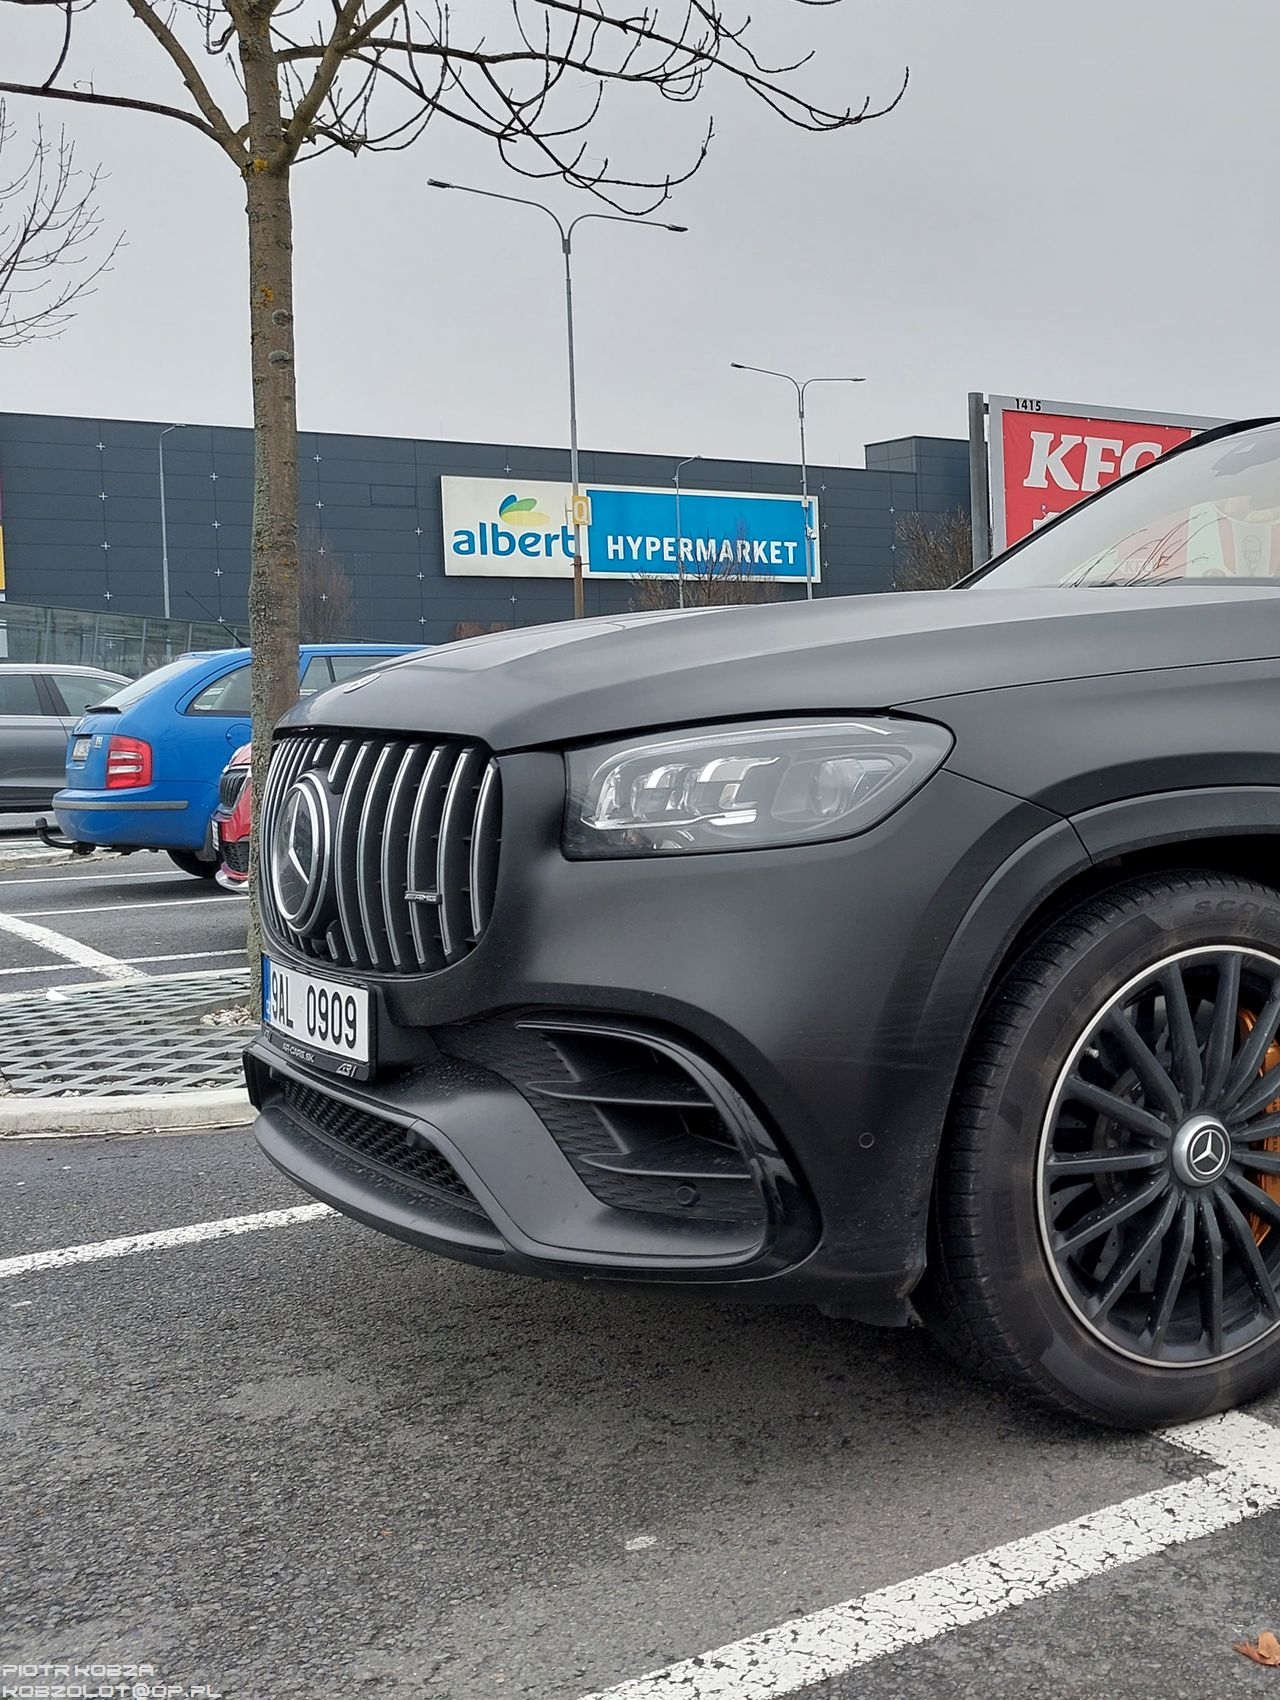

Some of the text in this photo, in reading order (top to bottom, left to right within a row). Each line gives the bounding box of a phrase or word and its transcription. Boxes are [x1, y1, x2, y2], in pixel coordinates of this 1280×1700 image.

[1015, 399, 1041, 411] 1415
[452, 521, 574, 558] albert
[606, 535, 798, 565] HYPERMARKET
[271, 970, 357, 1049] 9AL 0909
